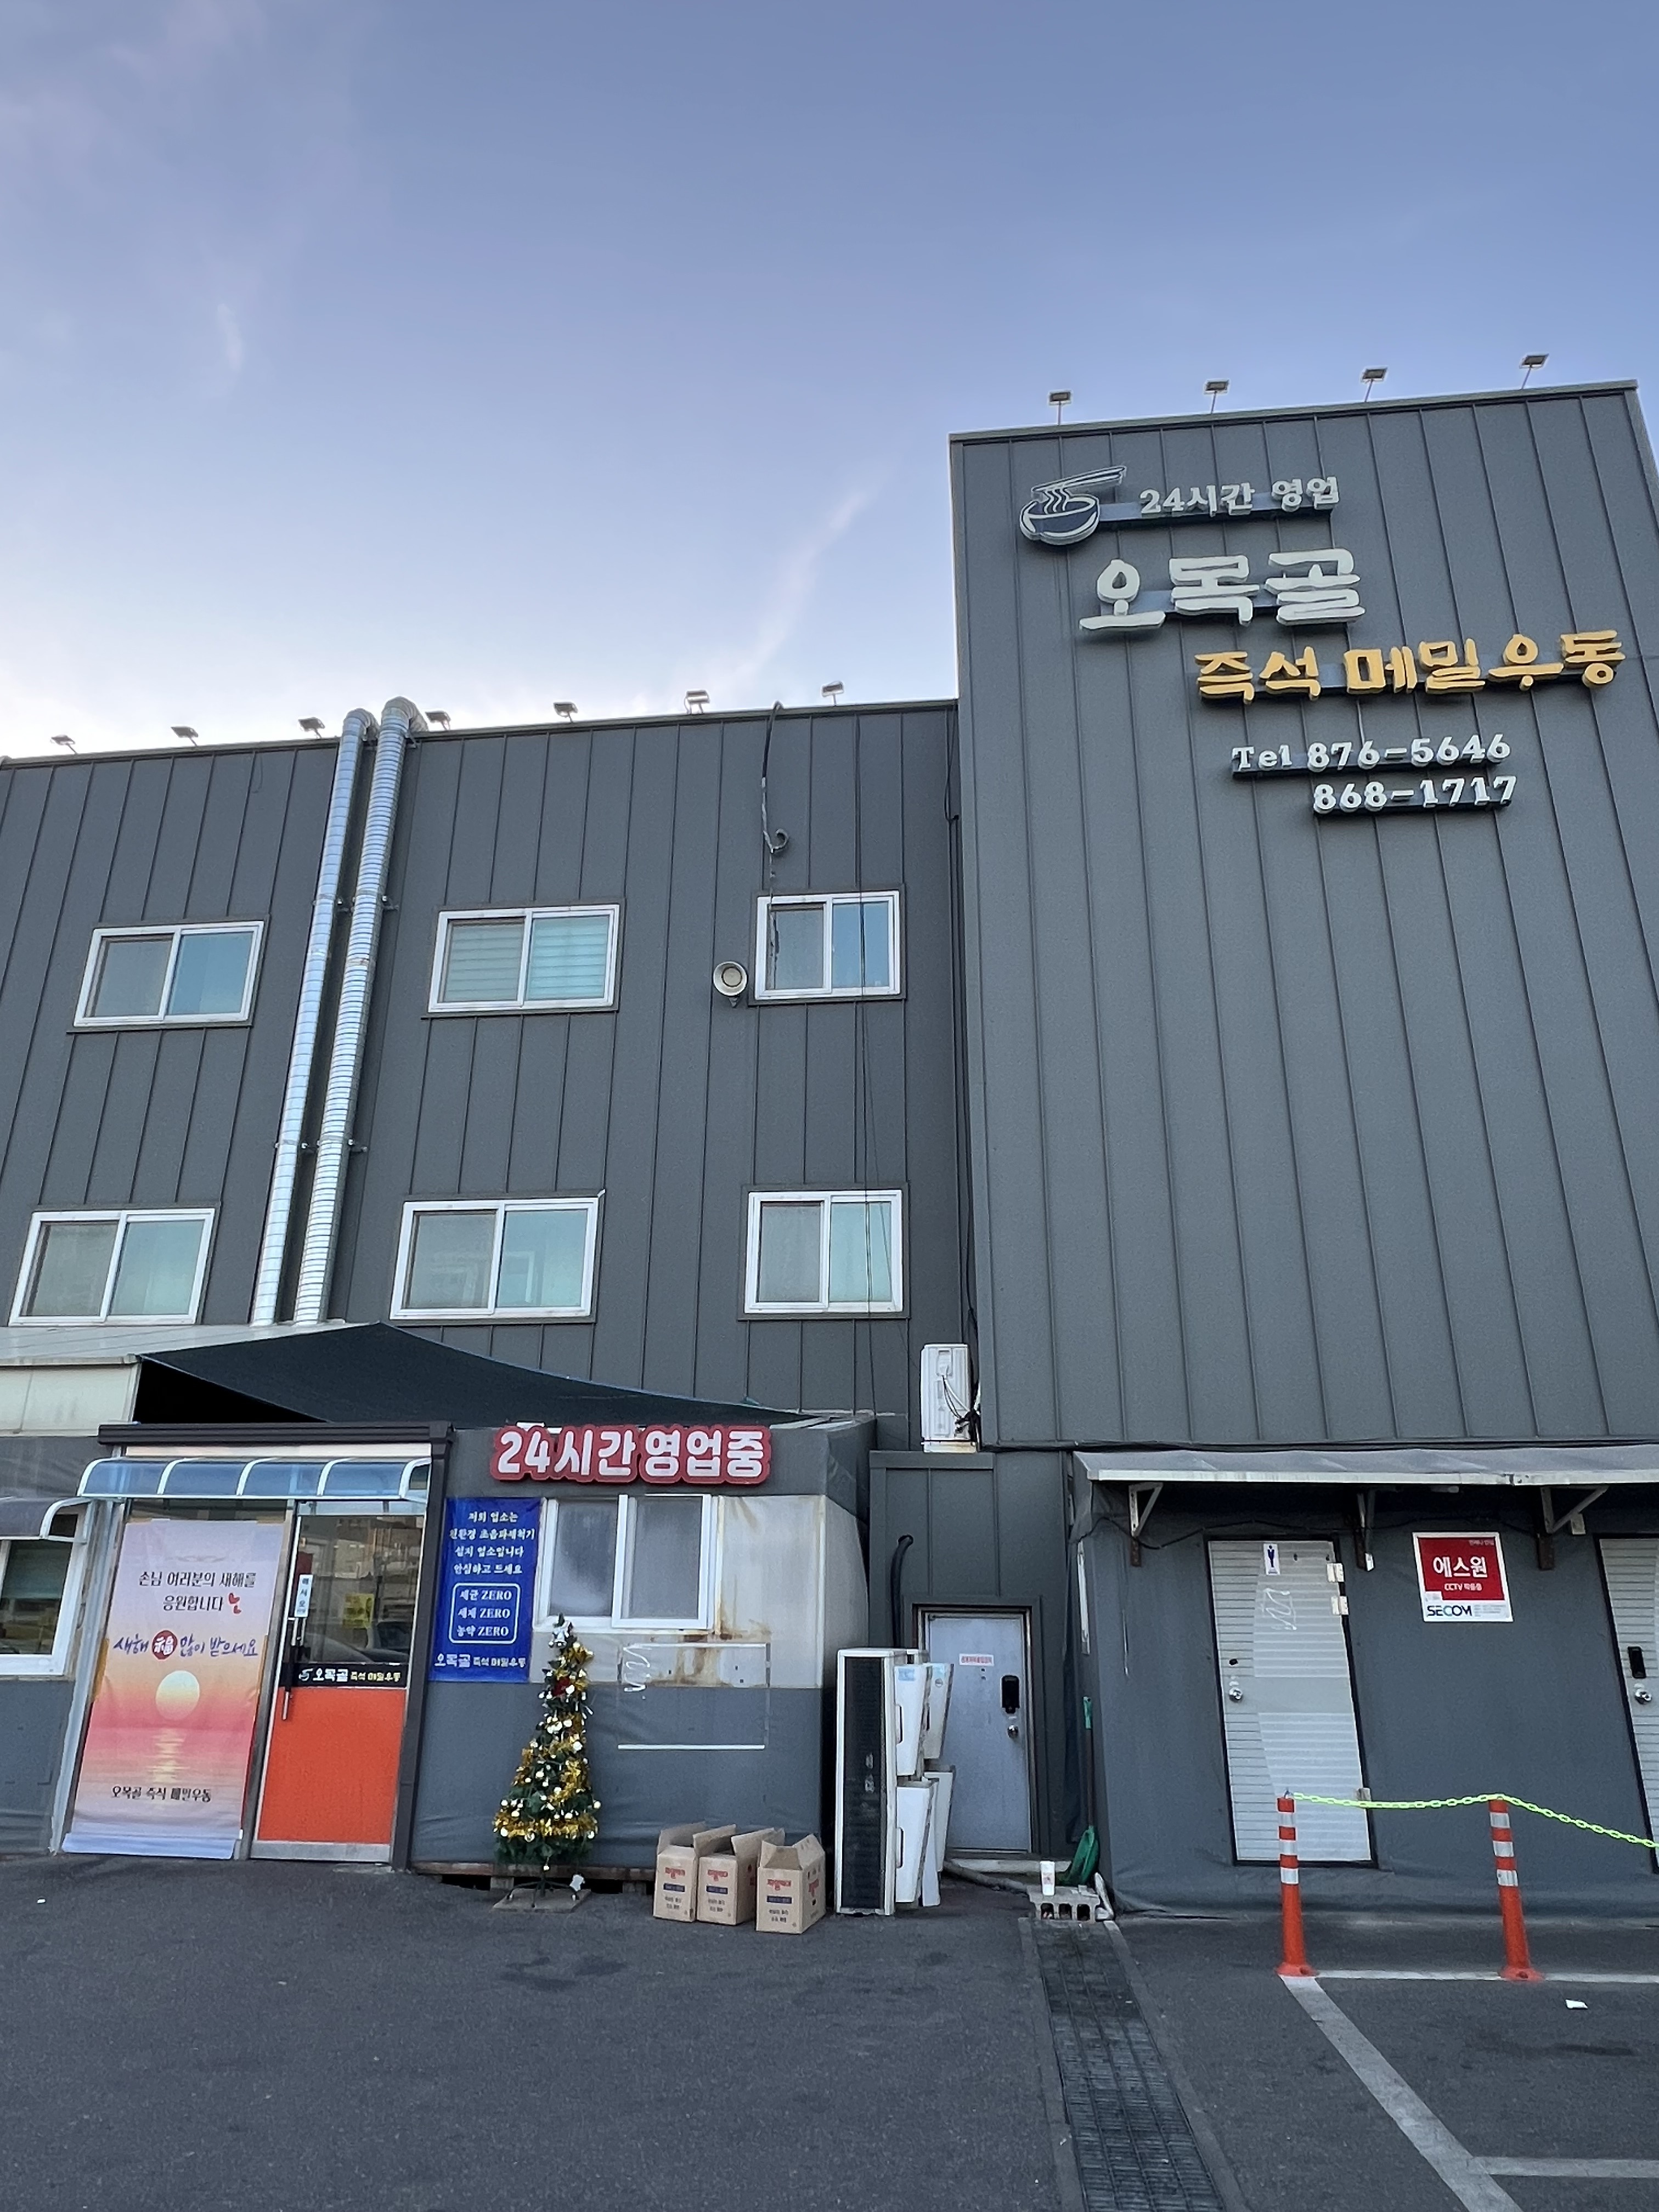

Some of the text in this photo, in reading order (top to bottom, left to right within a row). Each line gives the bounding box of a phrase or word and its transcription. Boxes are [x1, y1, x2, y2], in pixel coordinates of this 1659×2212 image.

[1140, 476, 1340, 517] 24시간 영업
[1079, 549, 1365, 631] 오목골
[1195, 630, 1626, 704] 즉석 메밀우동
[1232, 733, 1511, 772] Tel 876-5646
[1313, 775, 1517, 814] 868-1717
[490, 1511, 518, 1523] 업소는
[477, 1545, 524, 1558] 업소입니다
[453, 1562, 522, 1575] 안심하고 드세요
[1432, 1556, 1488, 1578] 에스원
[139, 1571, 257, 1588] 손님 여러분의 새해를
[1444, 1583, 1463, 1591] CCTV
[163, 1595, 223, 1611] 응원합니다
[481, 1590, 512, 1601] ZERO
[479, 1608, 510, 1618] ZERO
[1426, 1605, 1472, 1617] SECOM
[477, 1626, 509, 1637] ZERO
[113, 1633, 149, 1655] 새해
[179, 1633, 206, 1657] 많이
[210, 1635, 258, 1657] 받으세요
[434, 1652, 471, 1668] 오목골
